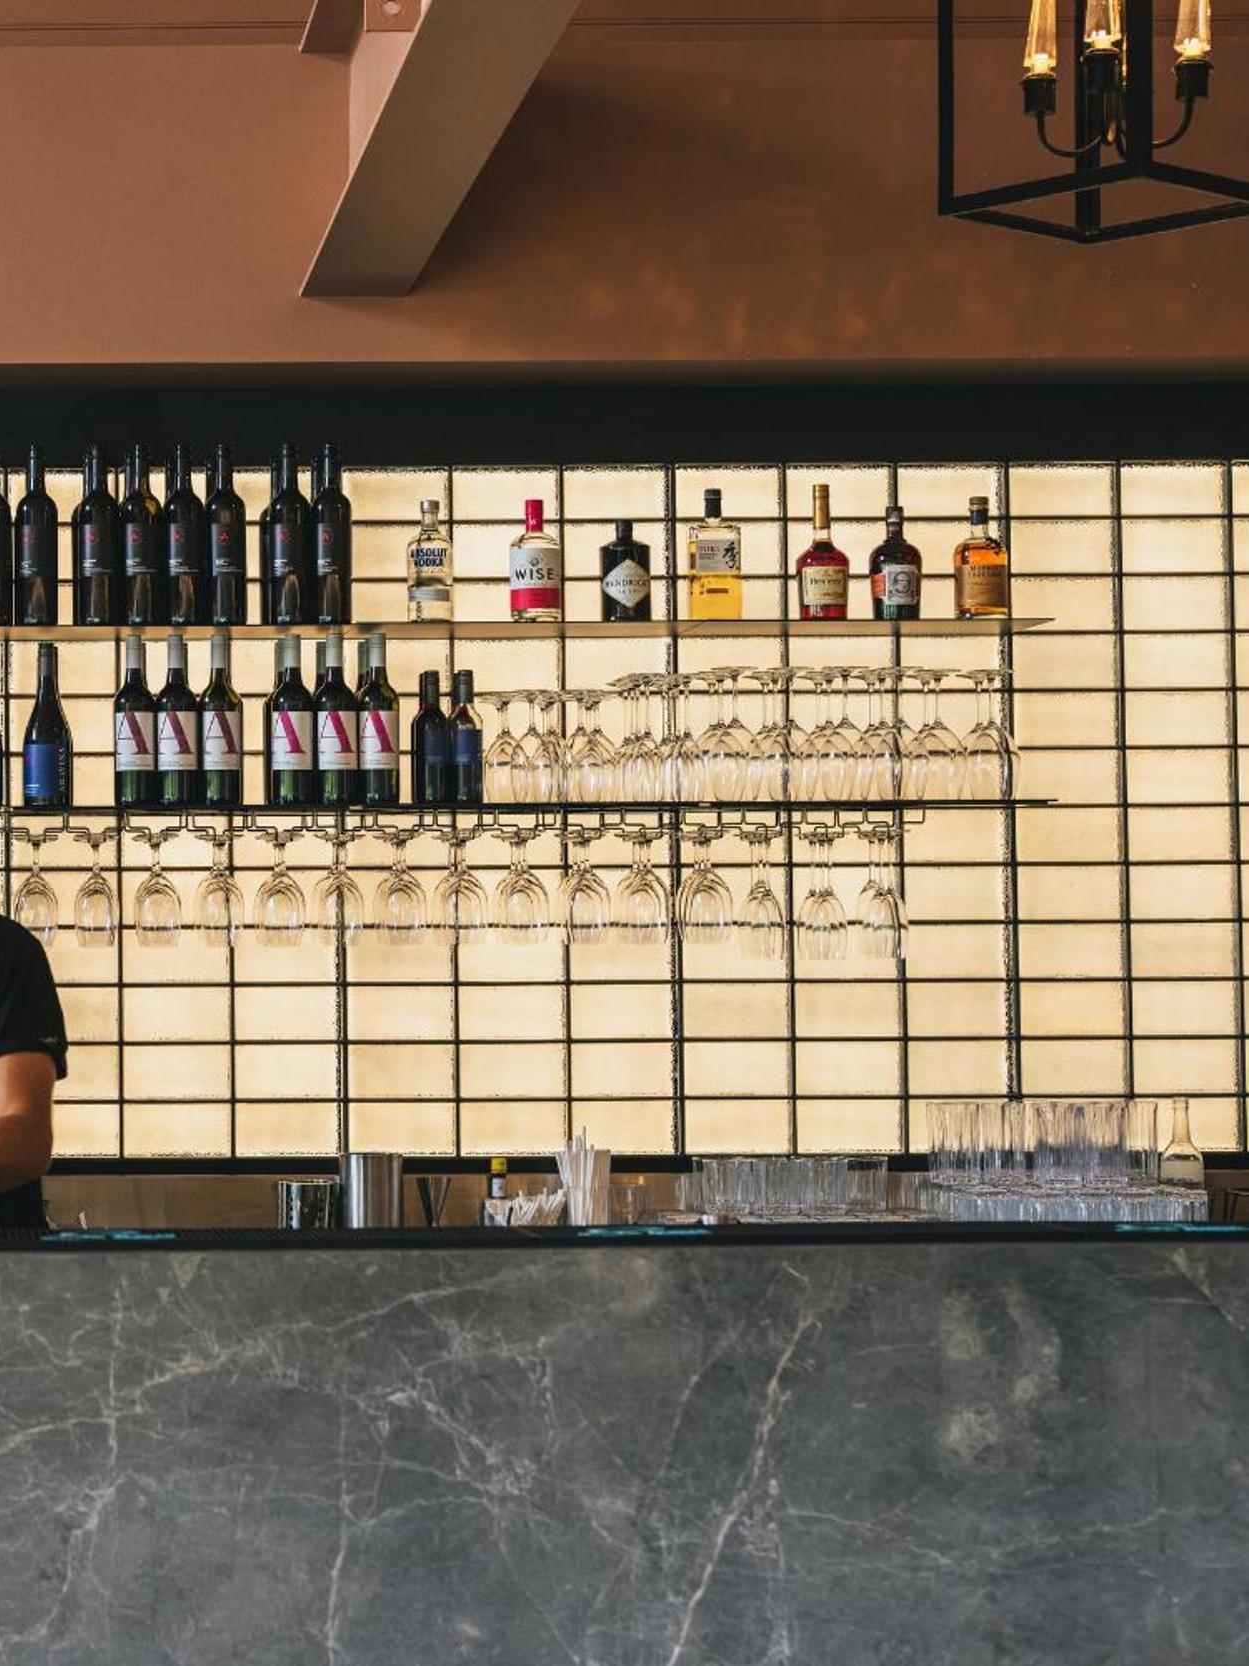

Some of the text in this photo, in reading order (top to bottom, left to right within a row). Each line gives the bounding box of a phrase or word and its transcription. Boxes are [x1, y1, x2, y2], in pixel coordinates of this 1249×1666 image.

[411, 548, 447, 558] ABSOLUT
[414, 558, 444, 568] VODKA
[515, 568, 555, 580] WISE
